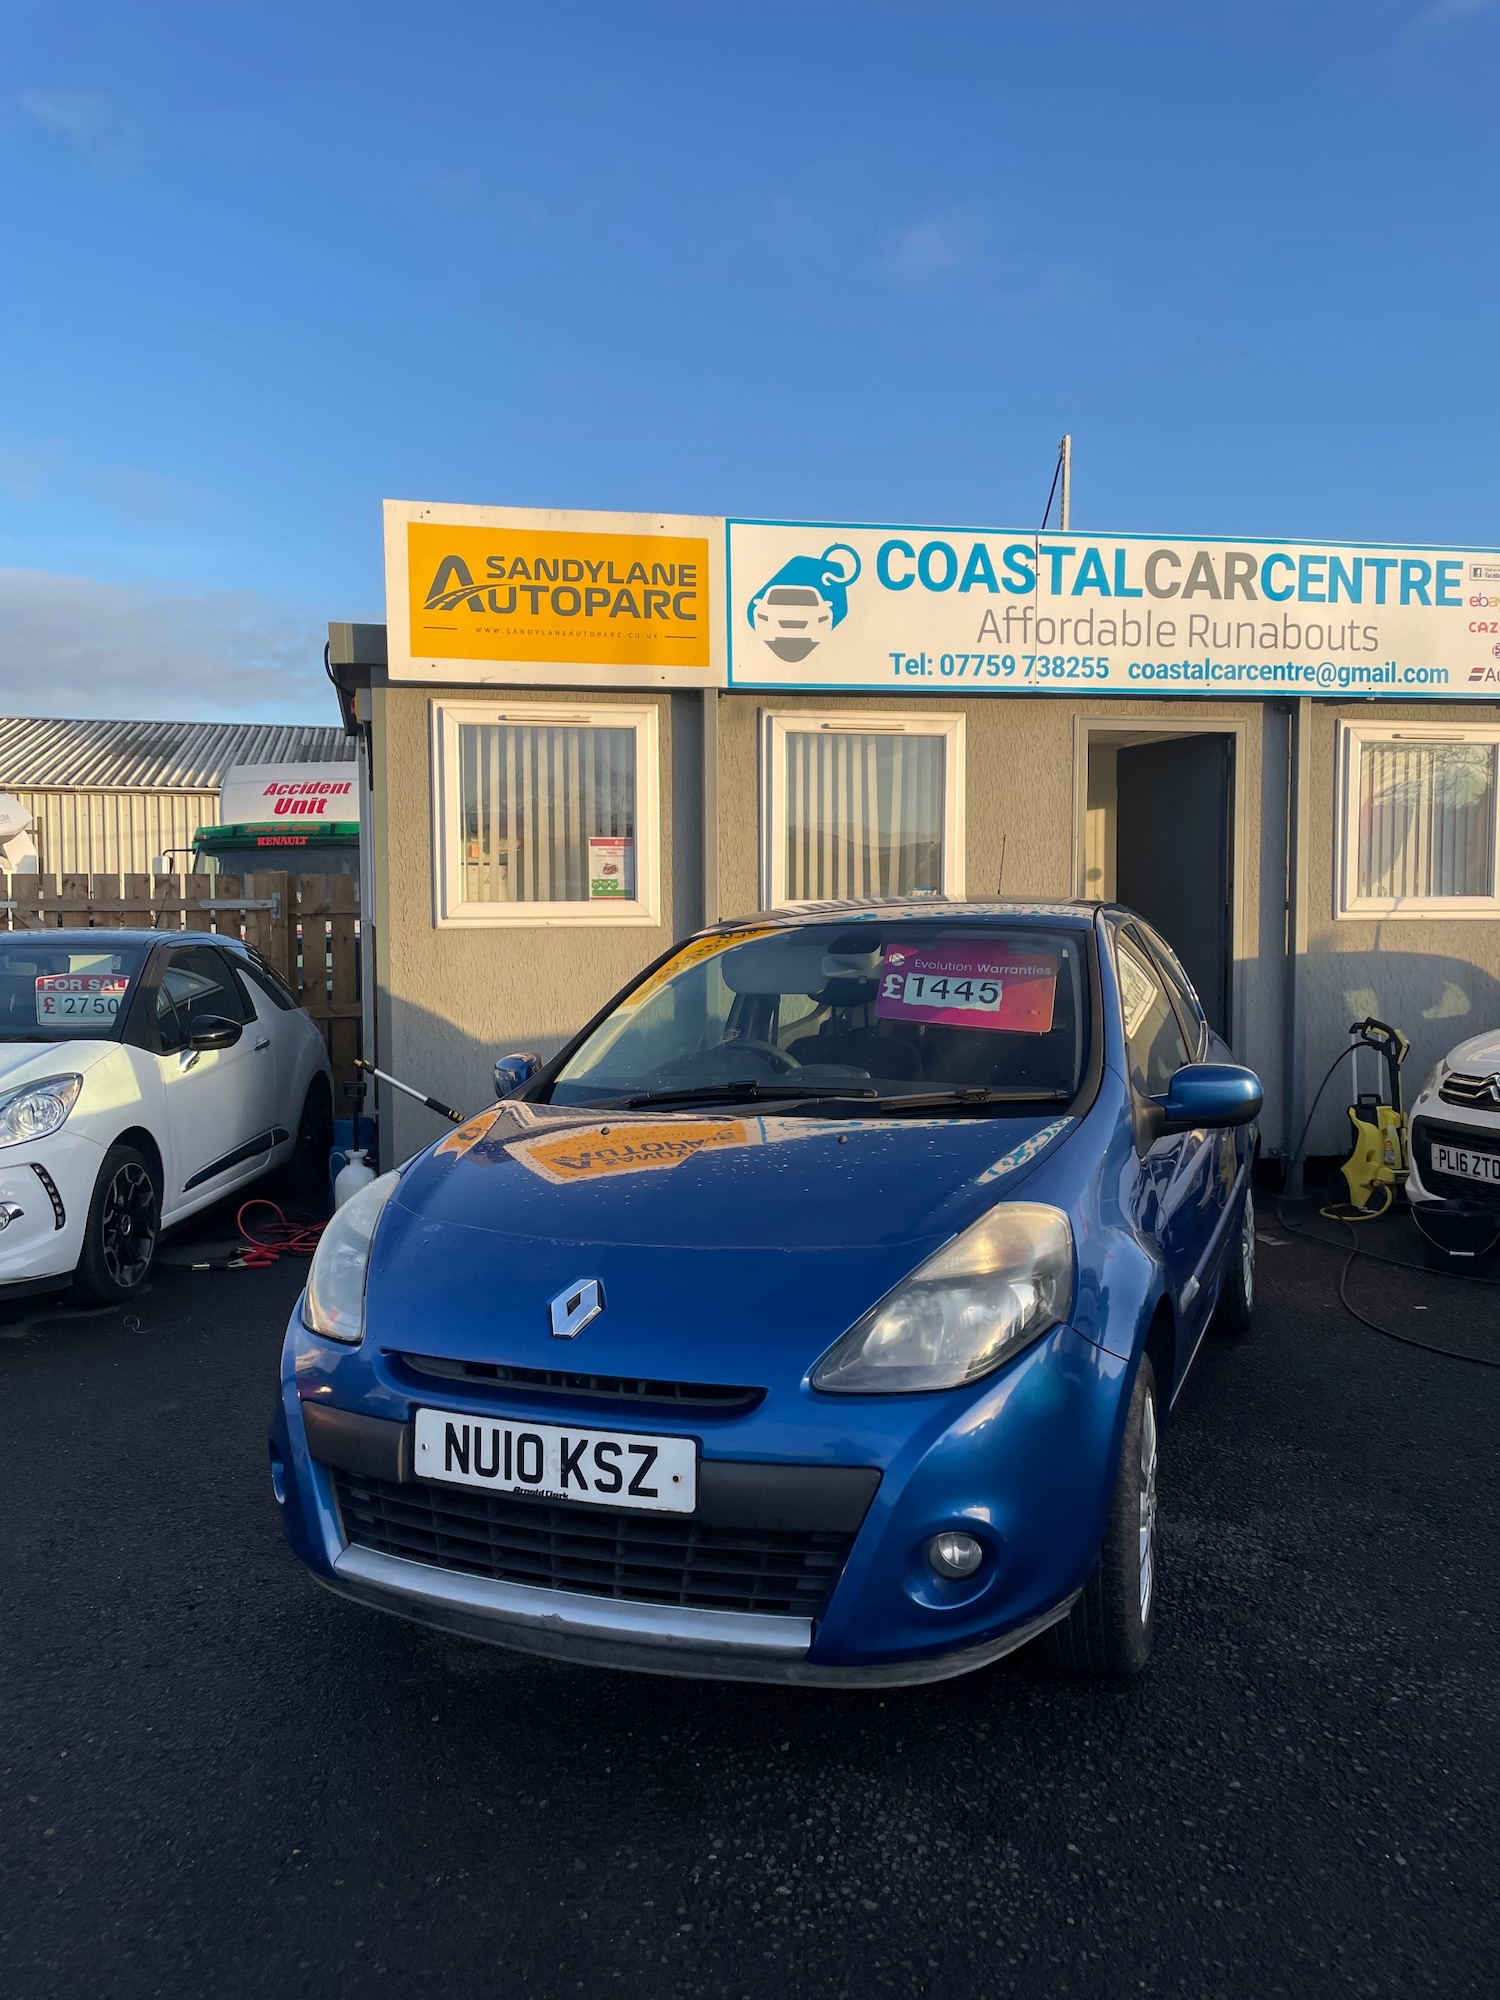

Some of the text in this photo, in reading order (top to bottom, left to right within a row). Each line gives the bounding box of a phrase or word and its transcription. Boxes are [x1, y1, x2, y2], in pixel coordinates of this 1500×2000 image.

[486, 555, 697, 588] SANDYLANE
[876, 539, 1464, 607] COASTALCARCENTRE
[423, 554, 697, 621] AUTOPARC
[475, 627, 659, 640] WWW.SANDYLANEAUTOPARC.CO.UK
[976, 605, 1379, 652] Affordable Runabouts
[1468, 621, 1500, 634] CAZ
[889, 652, 1449, 688] Tel: 07759 738255 coastalcarcentre@gmail.com
[263, 781, 352, 796] Accident
[273, 797, 328, 815] Unit
[257, 836, 308, 846] RENAULT
[914, 958, 1052, 976] Evolution Warranties
[43, 978, 83, 991] FOR
[1439, 1148, 1468, 1173] PL16
[444, 1422, 659, 1498] NU10 KSZ
